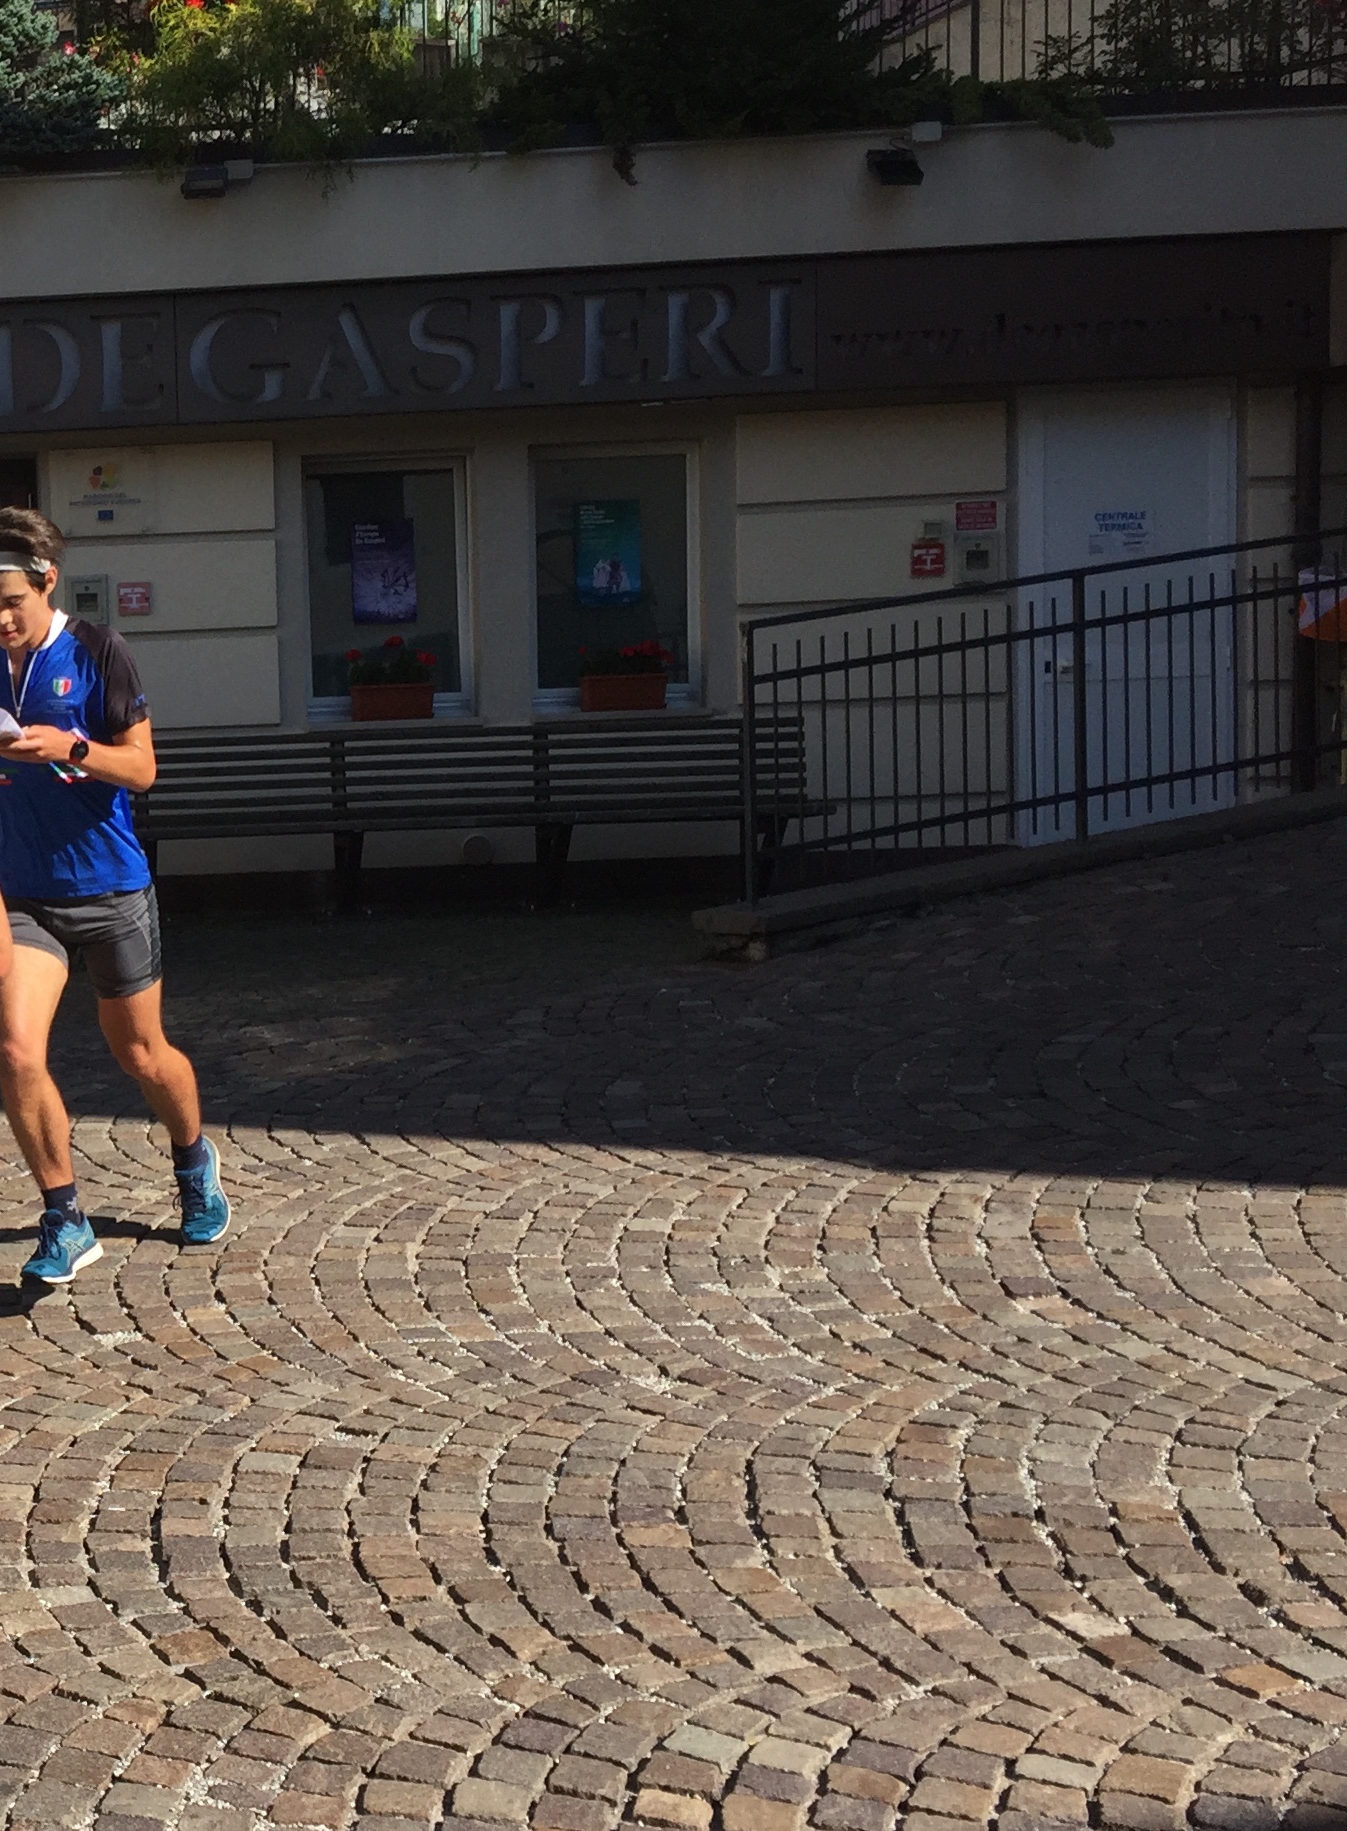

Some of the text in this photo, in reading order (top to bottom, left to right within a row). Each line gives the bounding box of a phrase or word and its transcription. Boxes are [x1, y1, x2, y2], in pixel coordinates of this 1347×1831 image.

[189, 277, 805, 404] GASPERI
[1094, 510, 1146, 522] CENTRALE
[1098, 522, 1143, 533] TERMICA
